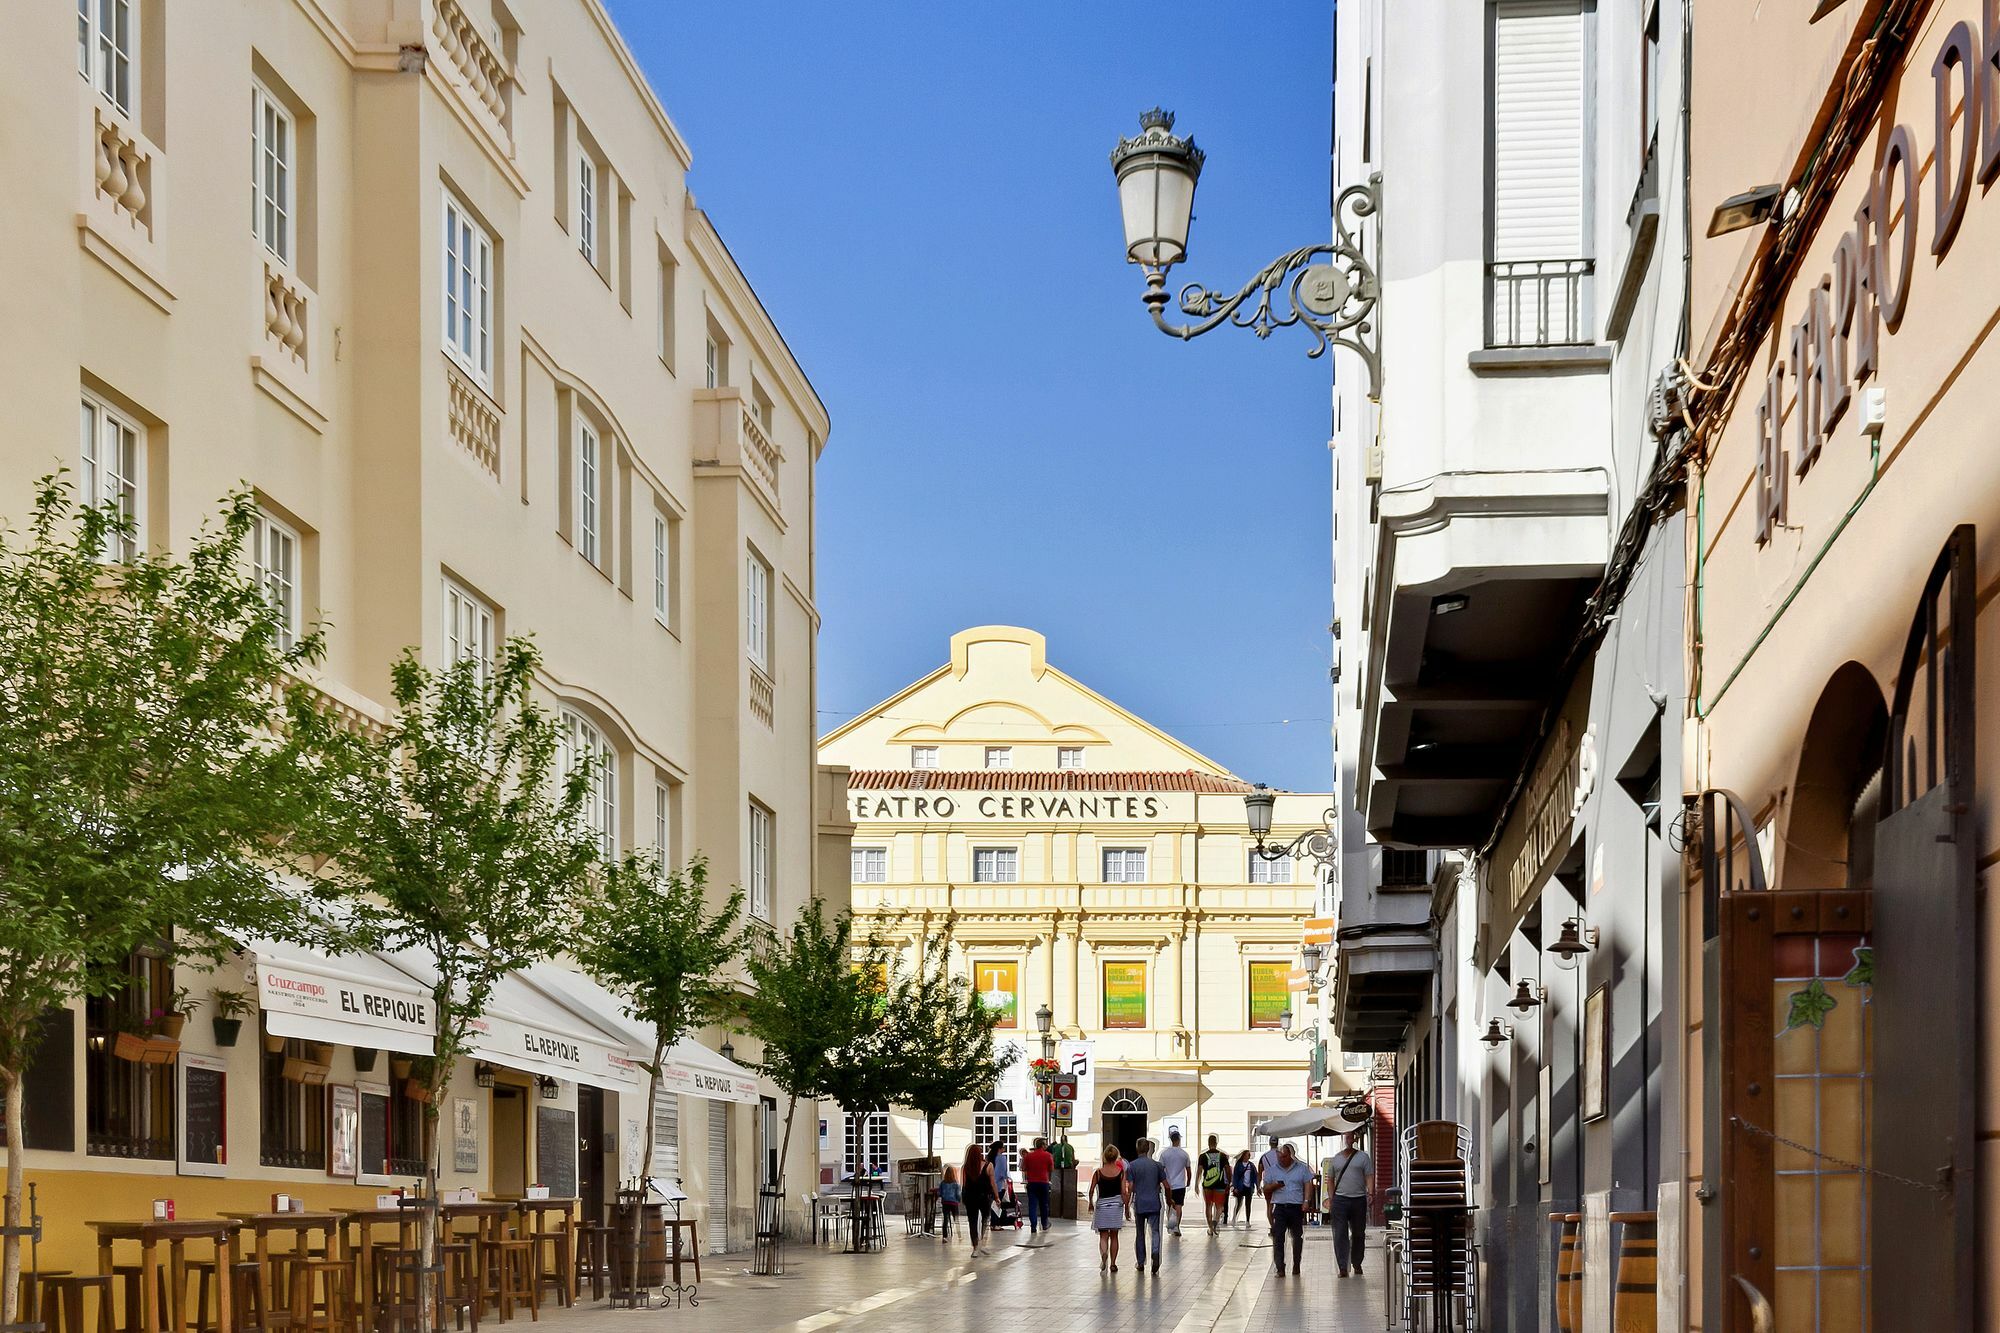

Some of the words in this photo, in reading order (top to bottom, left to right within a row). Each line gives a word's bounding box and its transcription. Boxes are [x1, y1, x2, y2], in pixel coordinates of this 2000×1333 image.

[1754, 360, 1789, 546] EL
[1791, 123, 1920, 477] TAPEO
[855, 796, 955, 818] EATRO
[978, 797, 1158, 818] CERVANTES
[267, 973, 325, 996] Cruzcampo
[340, 990, 360, 1014] EL
[363, 994, 426, 1025] REPIQUE
[524, 1033, 539, 1053] EL
[539, 1037, 580, 1063] REPIQUE
[694, 1073, 704, 1088] EL
[704, 1075, 732, 1094] REPIQUE
